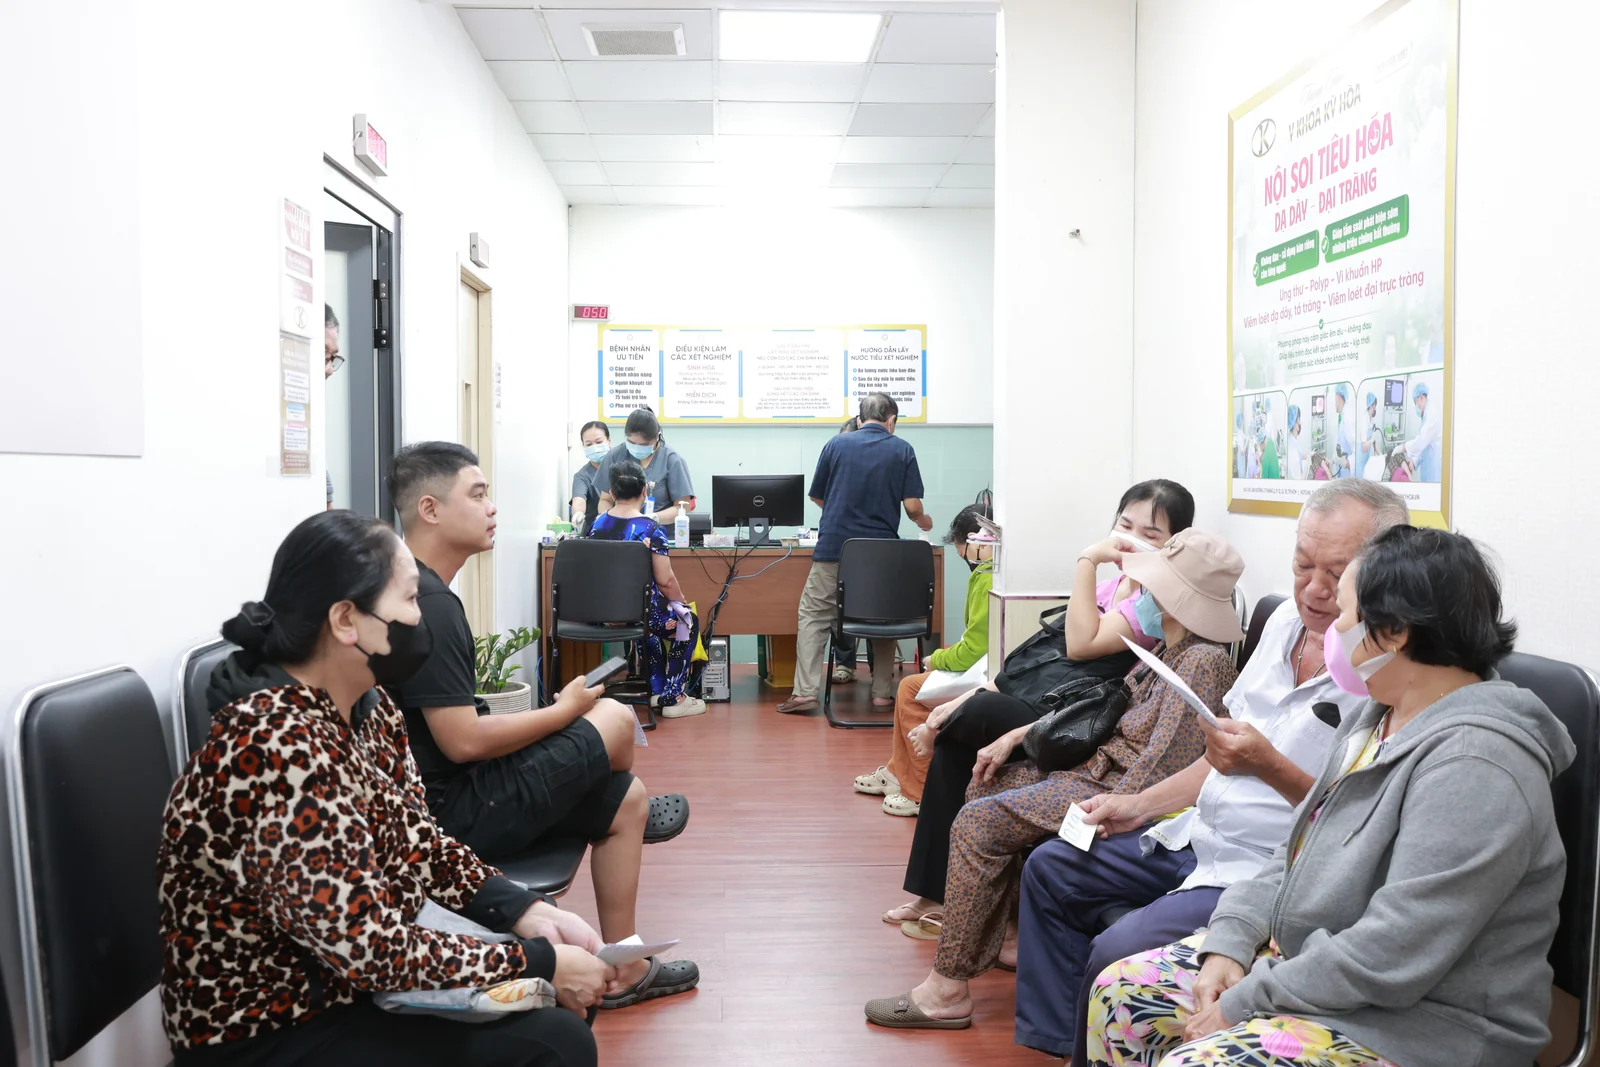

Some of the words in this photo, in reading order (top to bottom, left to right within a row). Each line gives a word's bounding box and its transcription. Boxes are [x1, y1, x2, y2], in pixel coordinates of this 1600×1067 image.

[1288, 121, 1295, 143] Y
[1296, 107, 1321, 139] KHOA
[1339, 83, 1361, 114] HÒA
[1265, 165, 1287, 207] NỘI
[1291, 153, 1313, 193] SOI
[1318, 133, 1350, 180] TIÊU
[1356, 111, 1393, 163] HÓA
[1275, 208, 1287, 233] DẠ
[1289, 198, 1308, 227] DÀY
[1318, 185, 1336, 214] ĐẠI
[1339, 167, 1377, 204] TRÀNG
[1310, 276, 1329, 293] Polyp
[1336, 271, 1345, 284] Vi
[1345, 260, 1370, 282] khuẩn
[1371, 257, 1383, 274] HP
[1302, 298, 1322, 316] tràng
[1328, 290, 1346, 307] Viêm
[1347, 284, 1363, 303] loét
[1364, 282, 1378, 302] đại
[1379, 278, 1397, 299] trực
[1399, 270, 1425, 289] tràng
[582, 307, 607, 318] 050
[609, 344, 629, 354] BỆNH
[630, 344, 651, 352] NHÂN
[675, 344, 692, 352] ĐIỀU
[693, 344, 710, 353] KIỆN
[711, 344, 727, 352] LÀM
[860, 346, 883, 354] HƯỚNG
[884, 345, 897, 353] DẪN
[897, 345, 909, 353] LẤY
[628, 353, 645, 361] TIÊN
[671, 352, 687, 360] CÁC
[688, 351, 702, 360] XÉT
[703, 353, 732, 362] NGHIỆM
[896, 354, 919, 362] NGHIỆM
